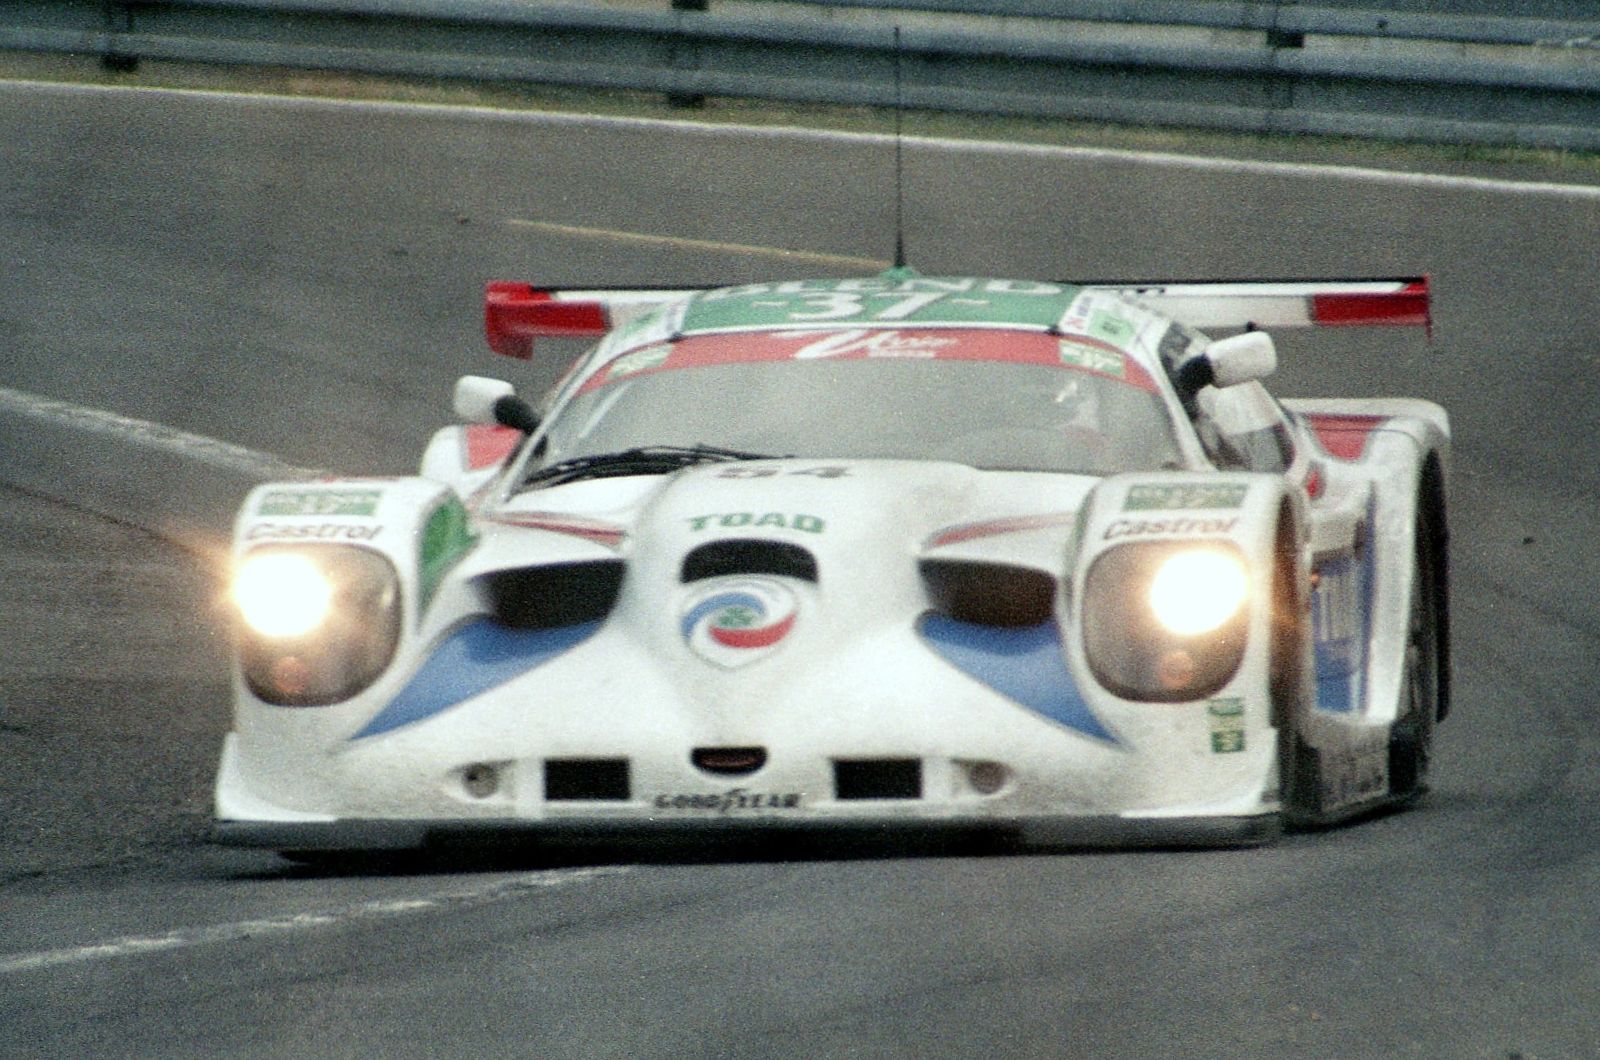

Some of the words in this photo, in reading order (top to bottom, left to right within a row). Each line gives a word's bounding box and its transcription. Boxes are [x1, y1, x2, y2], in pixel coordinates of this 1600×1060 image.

[247, 522, 384, 541] Castrol
[686, 511, 826, 534] TOAD
[1103, 517, 1240, 540] Castrol
[654, 787, 801, 813] GOODYEAR
